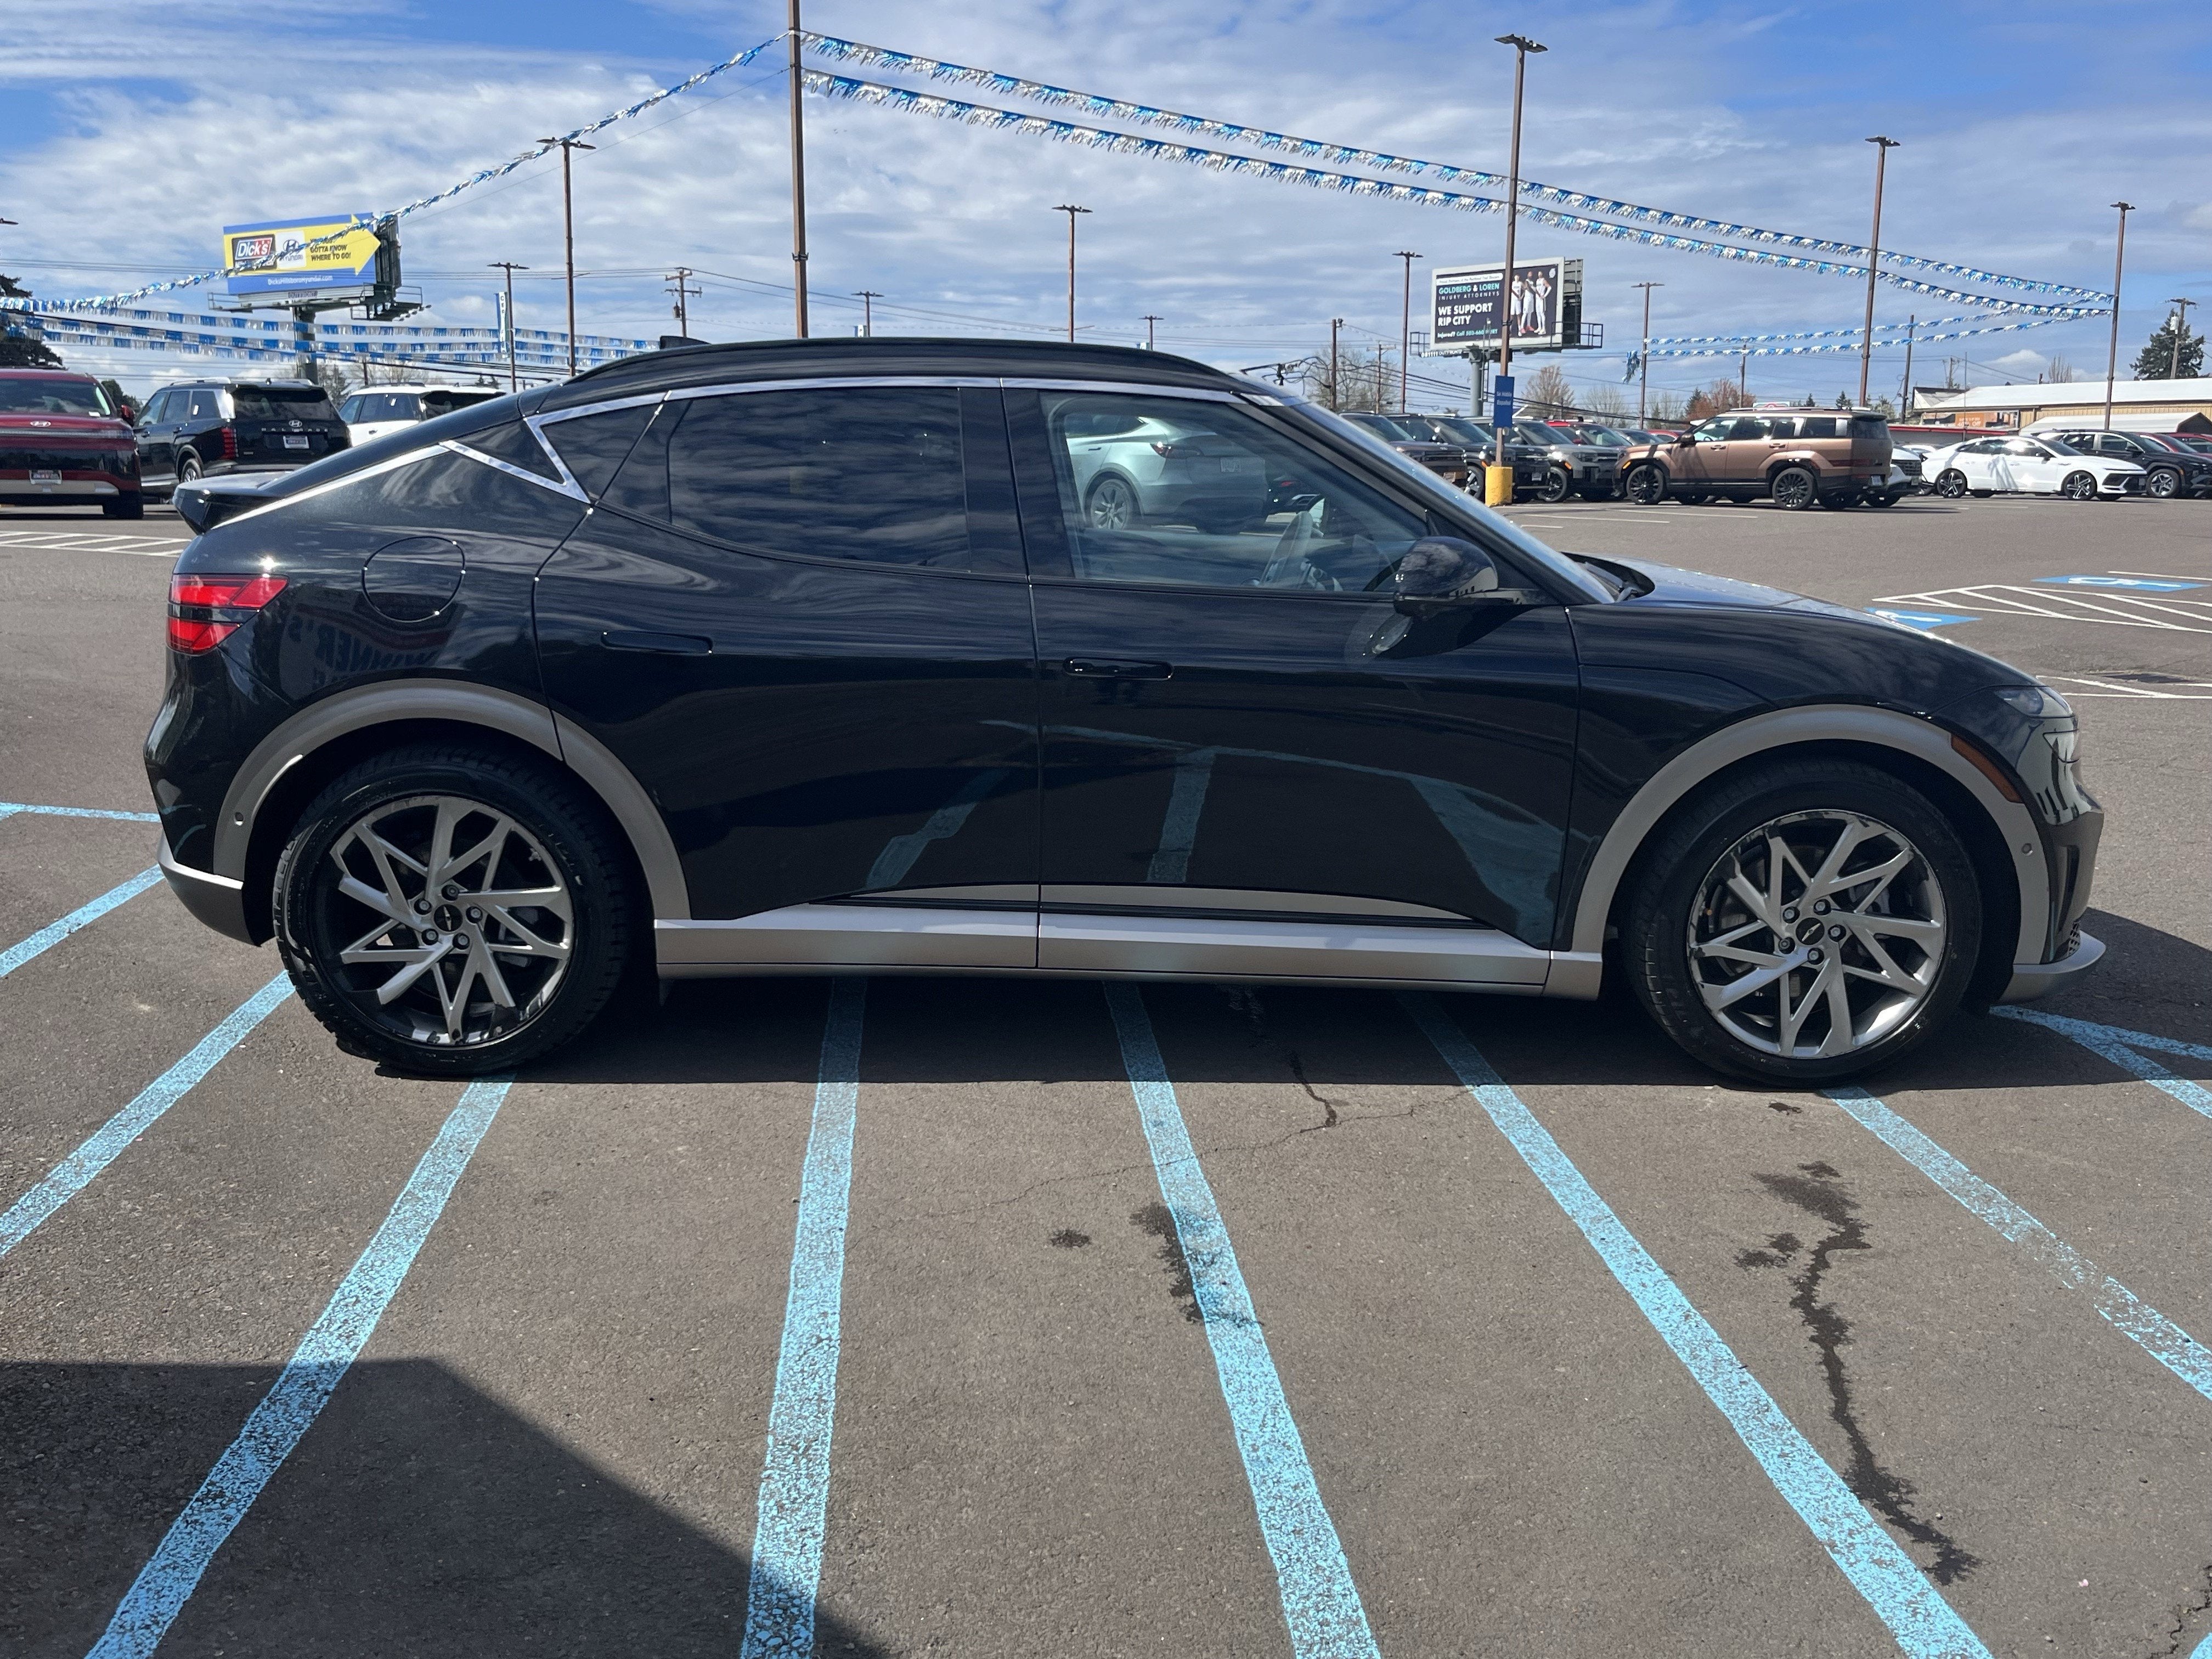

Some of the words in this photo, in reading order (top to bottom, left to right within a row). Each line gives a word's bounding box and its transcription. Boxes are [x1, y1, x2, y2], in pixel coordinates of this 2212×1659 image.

[237, 240, 269, 257] Dick's
[1438, 285, 1471, 294] GOLDBERG
[1438, 306, 1452, 315] WE
[1453, 302, 1493, 314] SUPPORT
[1438, 317, 1452, 326] RIP
[1452, 315, 1471, 325] CITY
